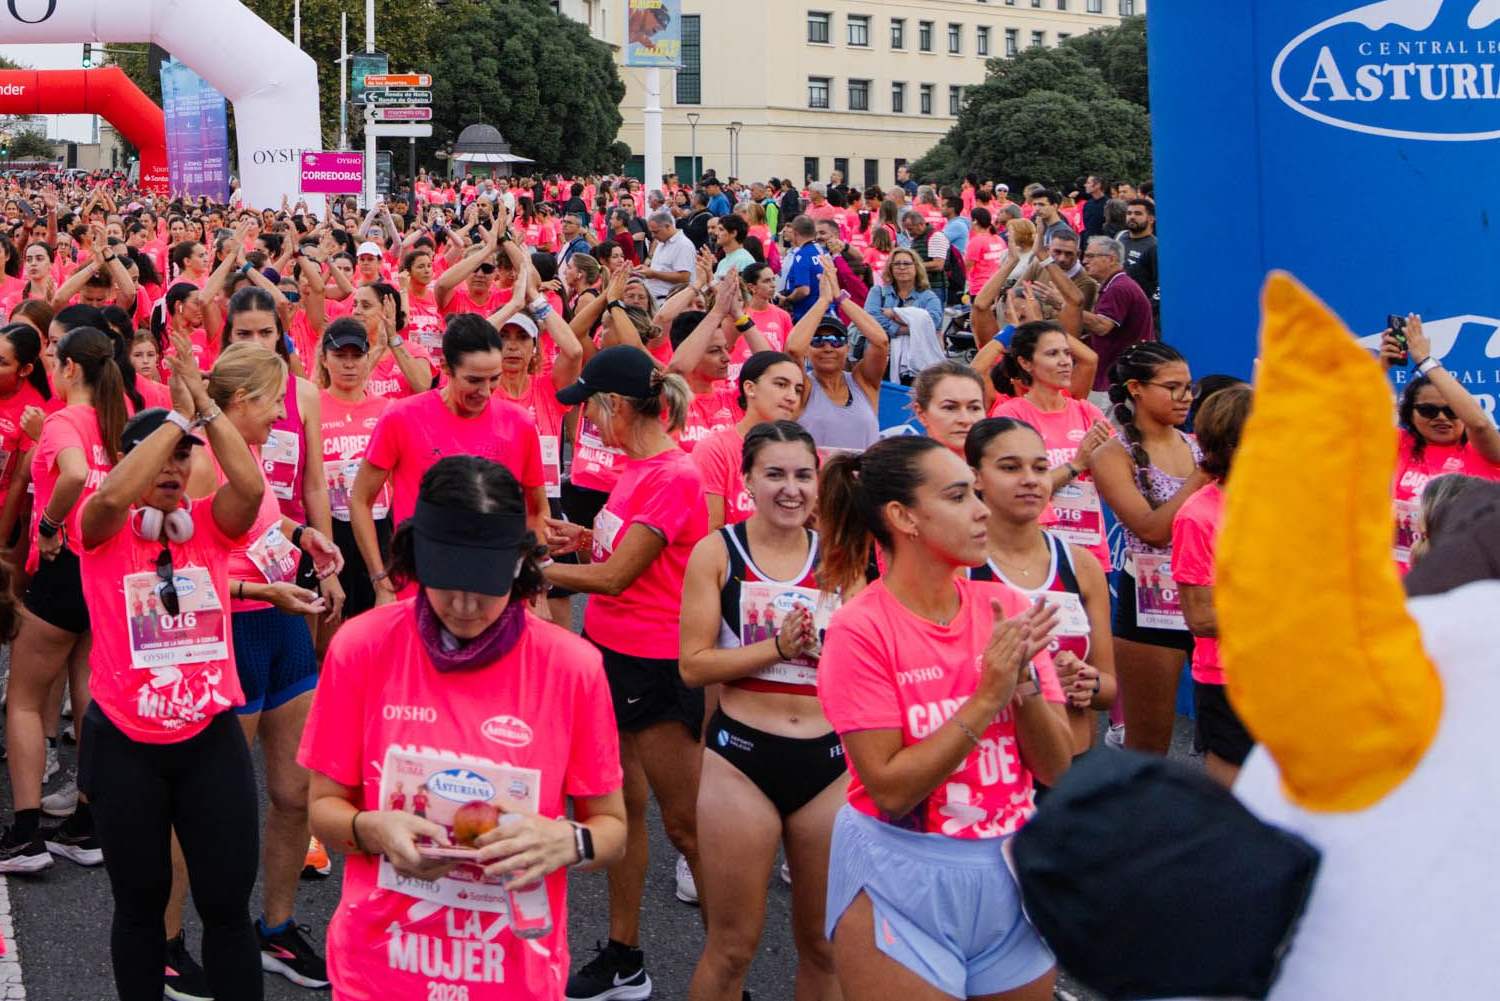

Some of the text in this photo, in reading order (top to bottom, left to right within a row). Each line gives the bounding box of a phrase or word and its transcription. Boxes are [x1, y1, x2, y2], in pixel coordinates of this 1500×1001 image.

[1358, 41, 1468, 56] CENTRAL
[1300, 46, 1500, 101] ASTURI
[253, 148, 313, 165] OYSH
[302, 171, 362, 181] CORREDORAS
[1055, 508, 1082, 521] 016
[160, 612, 197, 630] 016
[143, 653, 175, 663] OYSHO
[382, 704, 437, 723] OYSHO
[486, 726, 530, 741] ASTURIANA
[978, 736, 1018, 787] DE
[432, 777, 491, 799] ASTURIANA
[445, 905, 482, 939] LA
[388, 930, 505, 984] MUJER
[427, 980, 469, 1001] 2026
